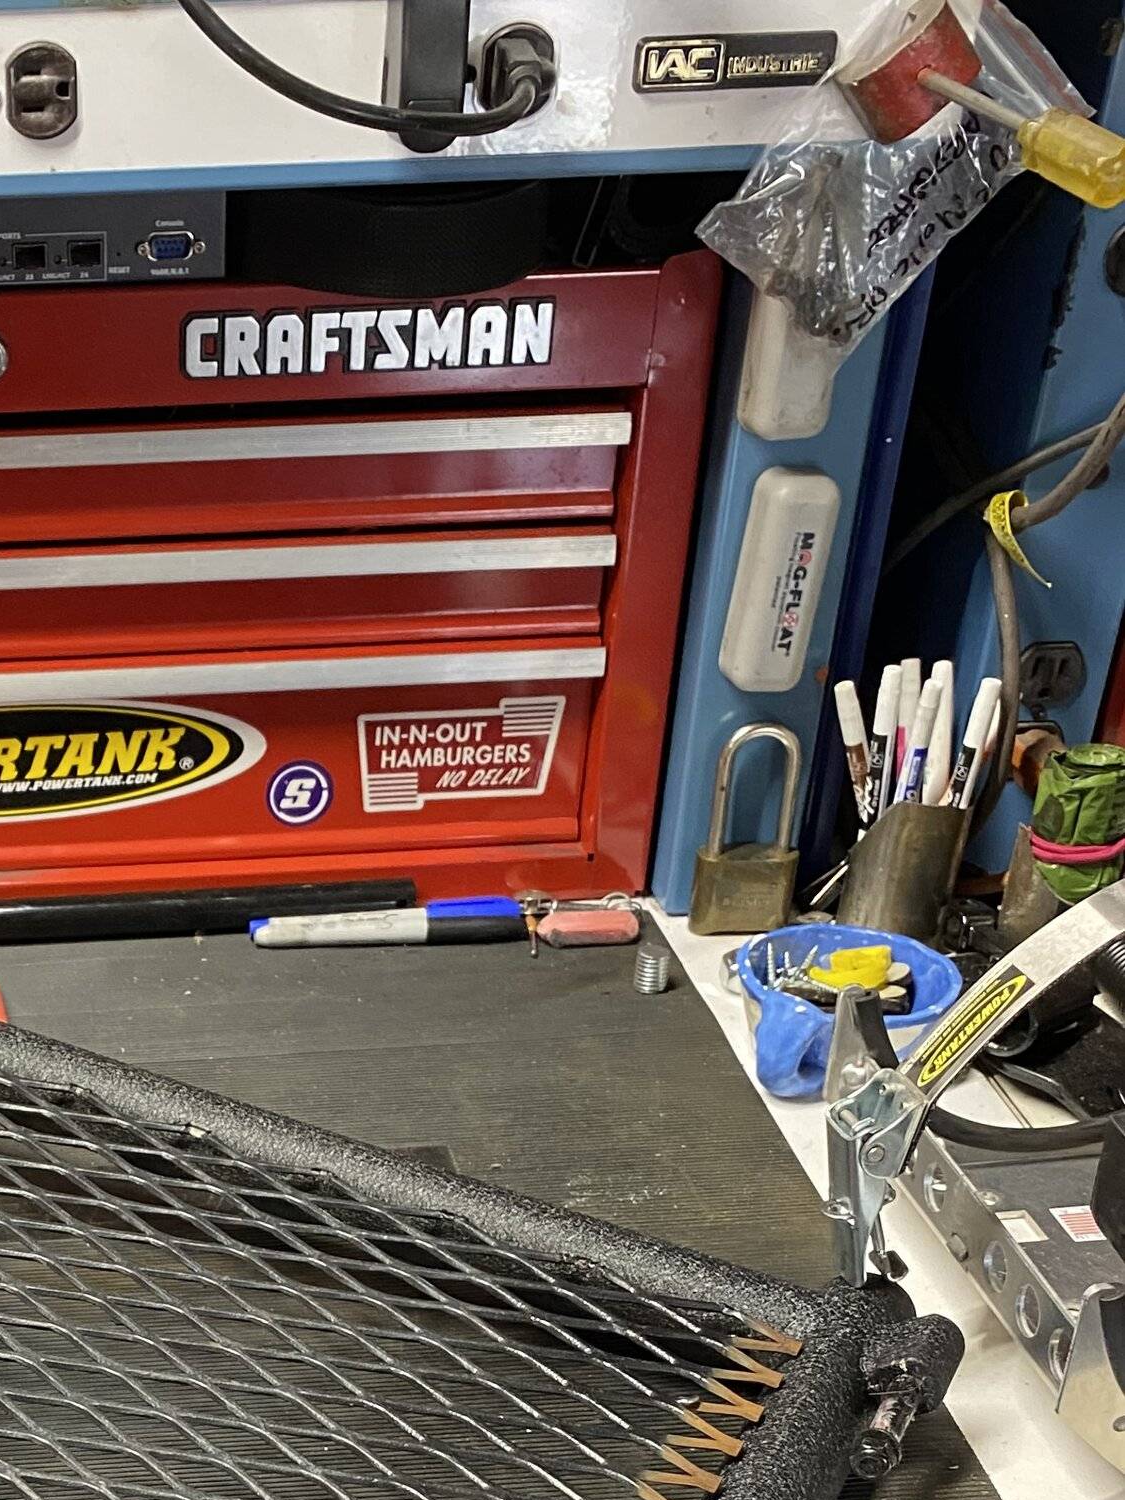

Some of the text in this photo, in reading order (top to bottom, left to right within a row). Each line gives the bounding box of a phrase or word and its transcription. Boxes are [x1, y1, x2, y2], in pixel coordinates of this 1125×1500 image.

[183, 302, 555, 378] CRAFTSMAN
[374, 722, 487, 747] IN-N-OUT
[380, 744, 532, 769] HAMBURGERS
[436, 766, 531, 789] NO DELAY
[932, 986, 1012, 1071] POWERTANK
